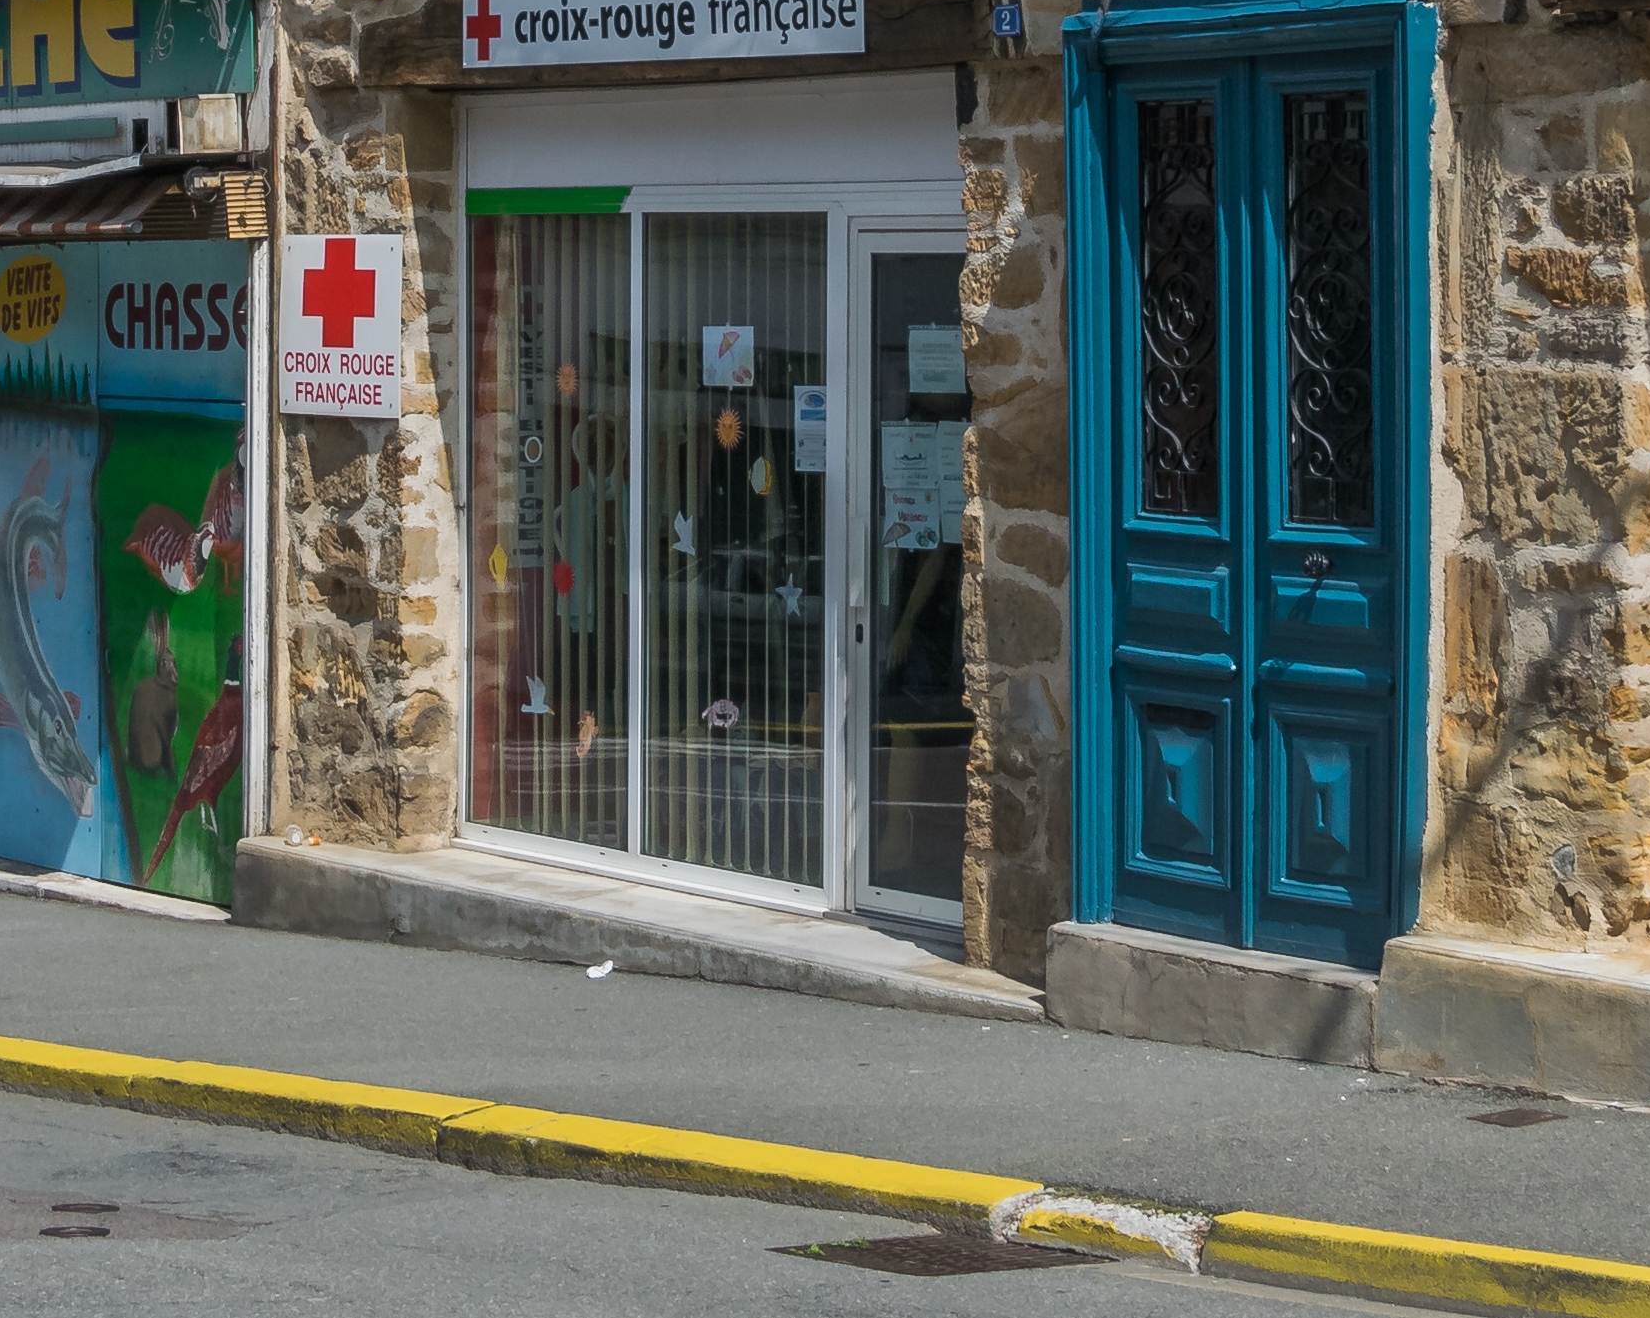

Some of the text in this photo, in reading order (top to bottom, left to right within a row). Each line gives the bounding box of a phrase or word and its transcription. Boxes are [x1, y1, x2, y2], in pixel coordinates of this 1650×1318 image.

[1001, 10, 1011, 31] 2
[5, 260, 53, 297] VENTE
[1, 295, 62, 333] DE VIFS
[284, 351, 396, 377] CROIX ROUGE
[295, 382, 383, 410] FRANÇAISE
